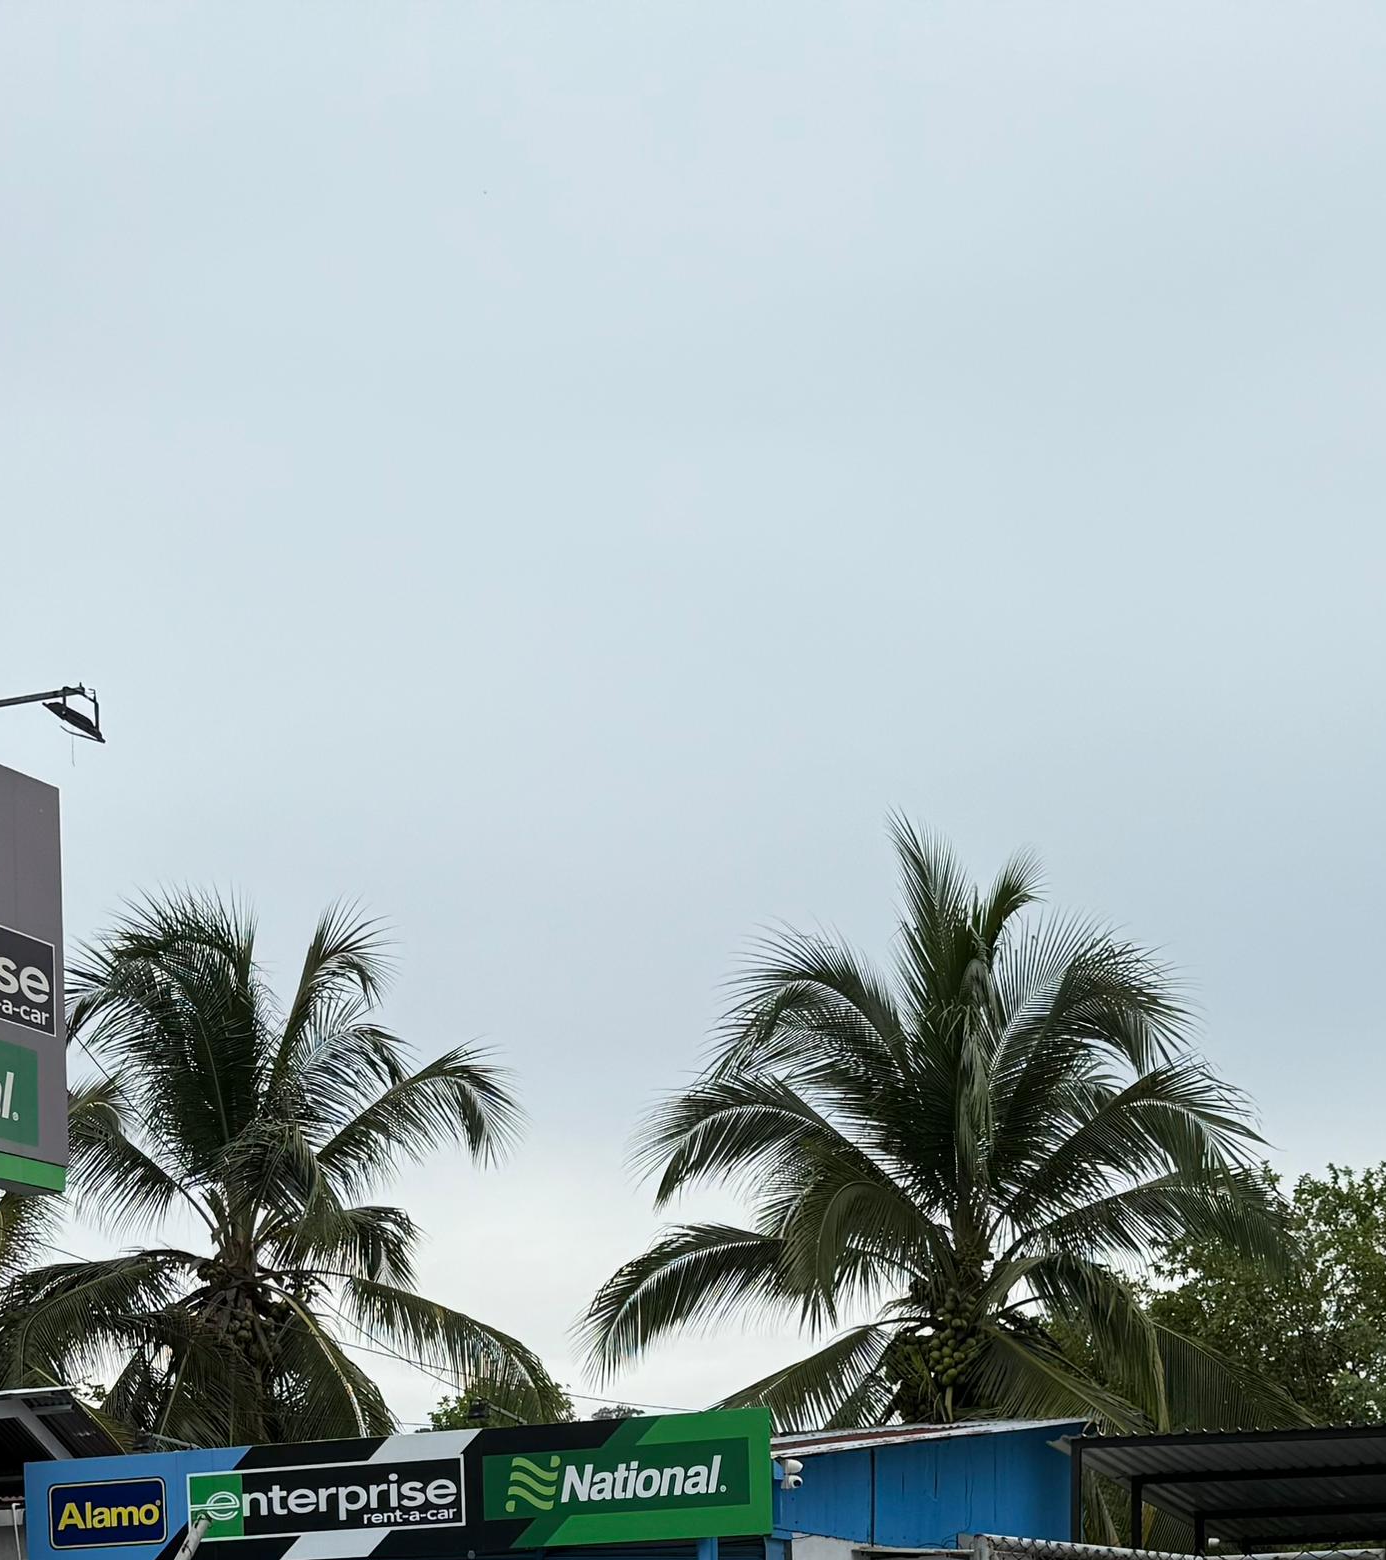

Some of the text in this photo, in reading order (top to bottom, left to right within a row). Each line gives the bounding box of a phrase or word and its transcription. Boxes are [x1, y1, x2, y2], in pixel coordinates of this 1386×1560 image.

[207, 1473, 457, 1522] enterprise
[58, 1501, 159, 1529] Alamo
[363, 1506, 457, 1525] rent-a-car
